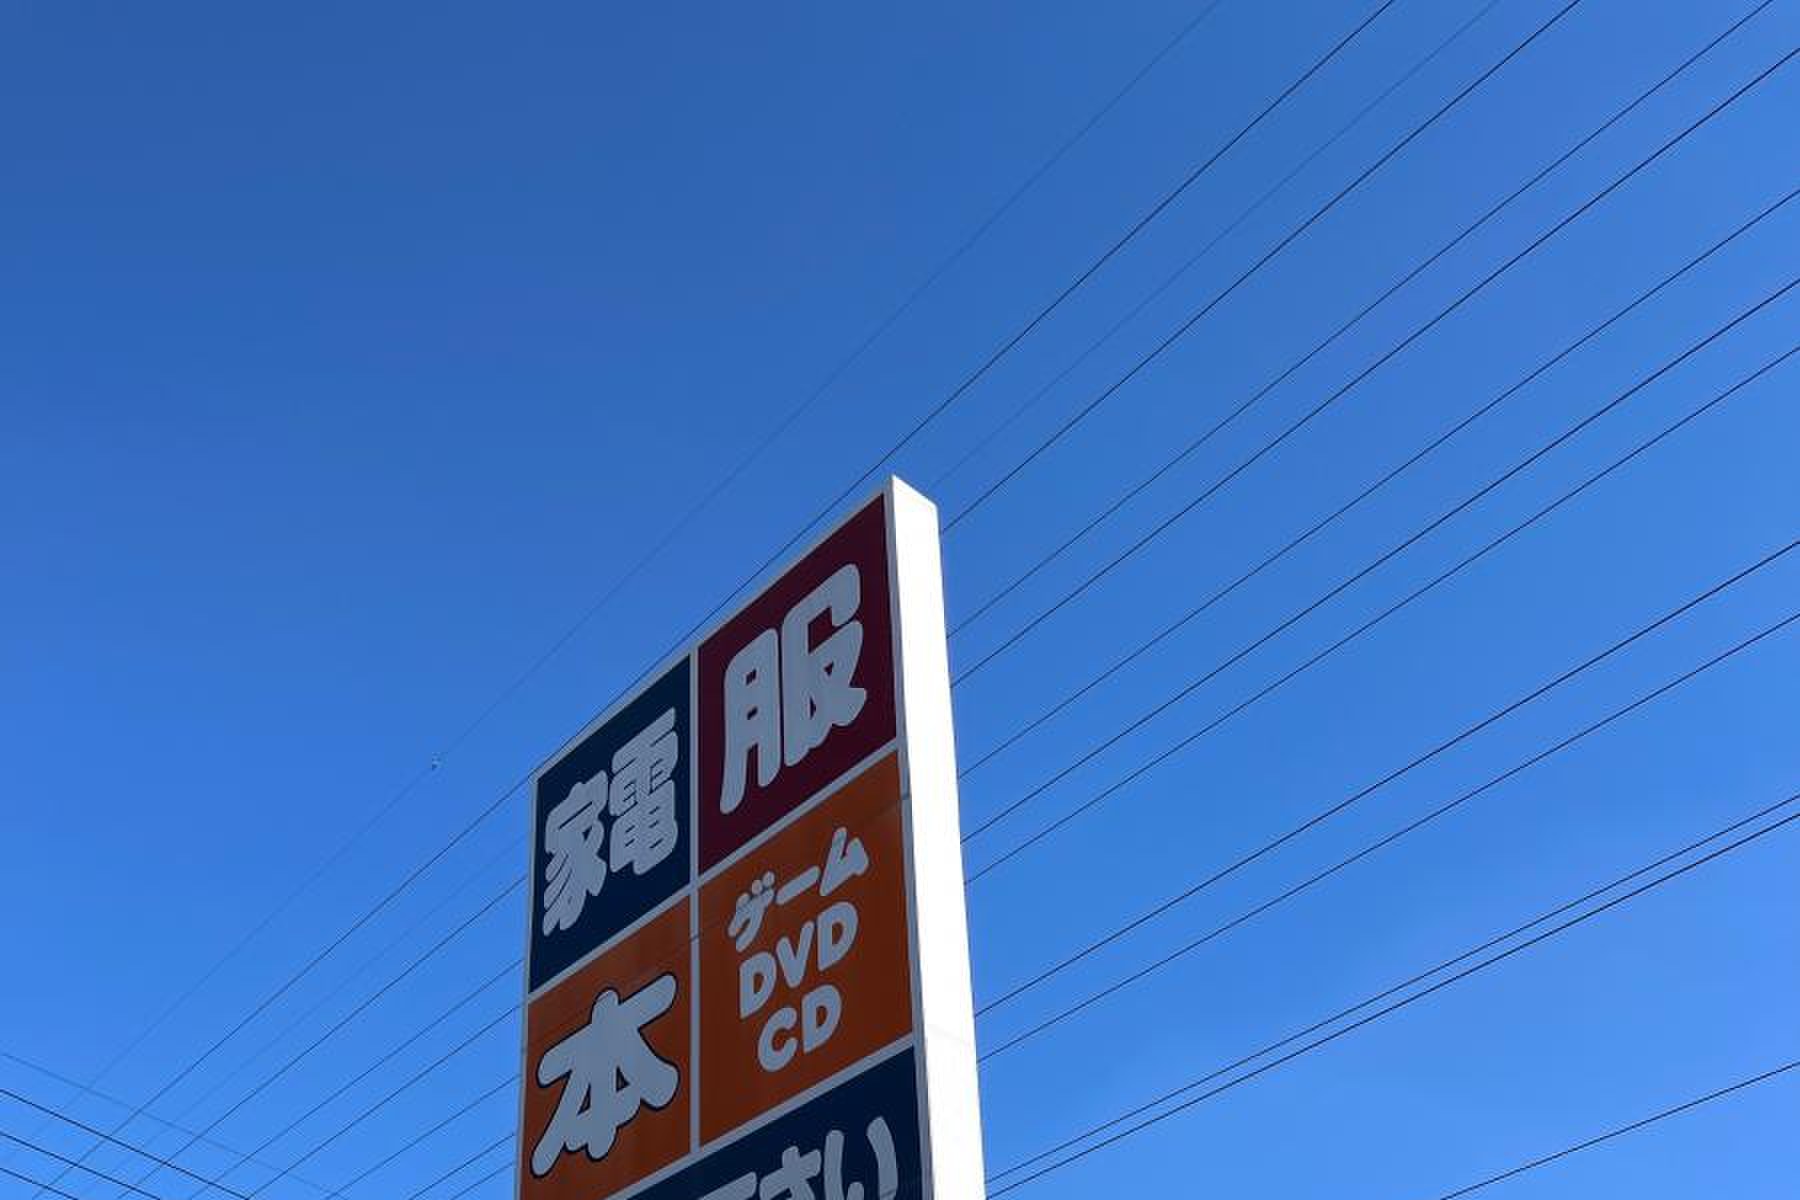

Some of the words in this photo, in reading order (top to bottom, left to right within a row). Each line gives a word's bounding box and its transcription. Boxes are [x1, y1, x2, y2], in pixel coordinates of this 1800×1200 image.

[720, 563, 867, 814] 服
[543, 707, 679, 936] 家電
[728, 827, 869, 952] ゲーム
[739, 901, 859, 1019] DVD
[758, 984, 842, 1072] CD
[531, 973, 680, 1177] 本
